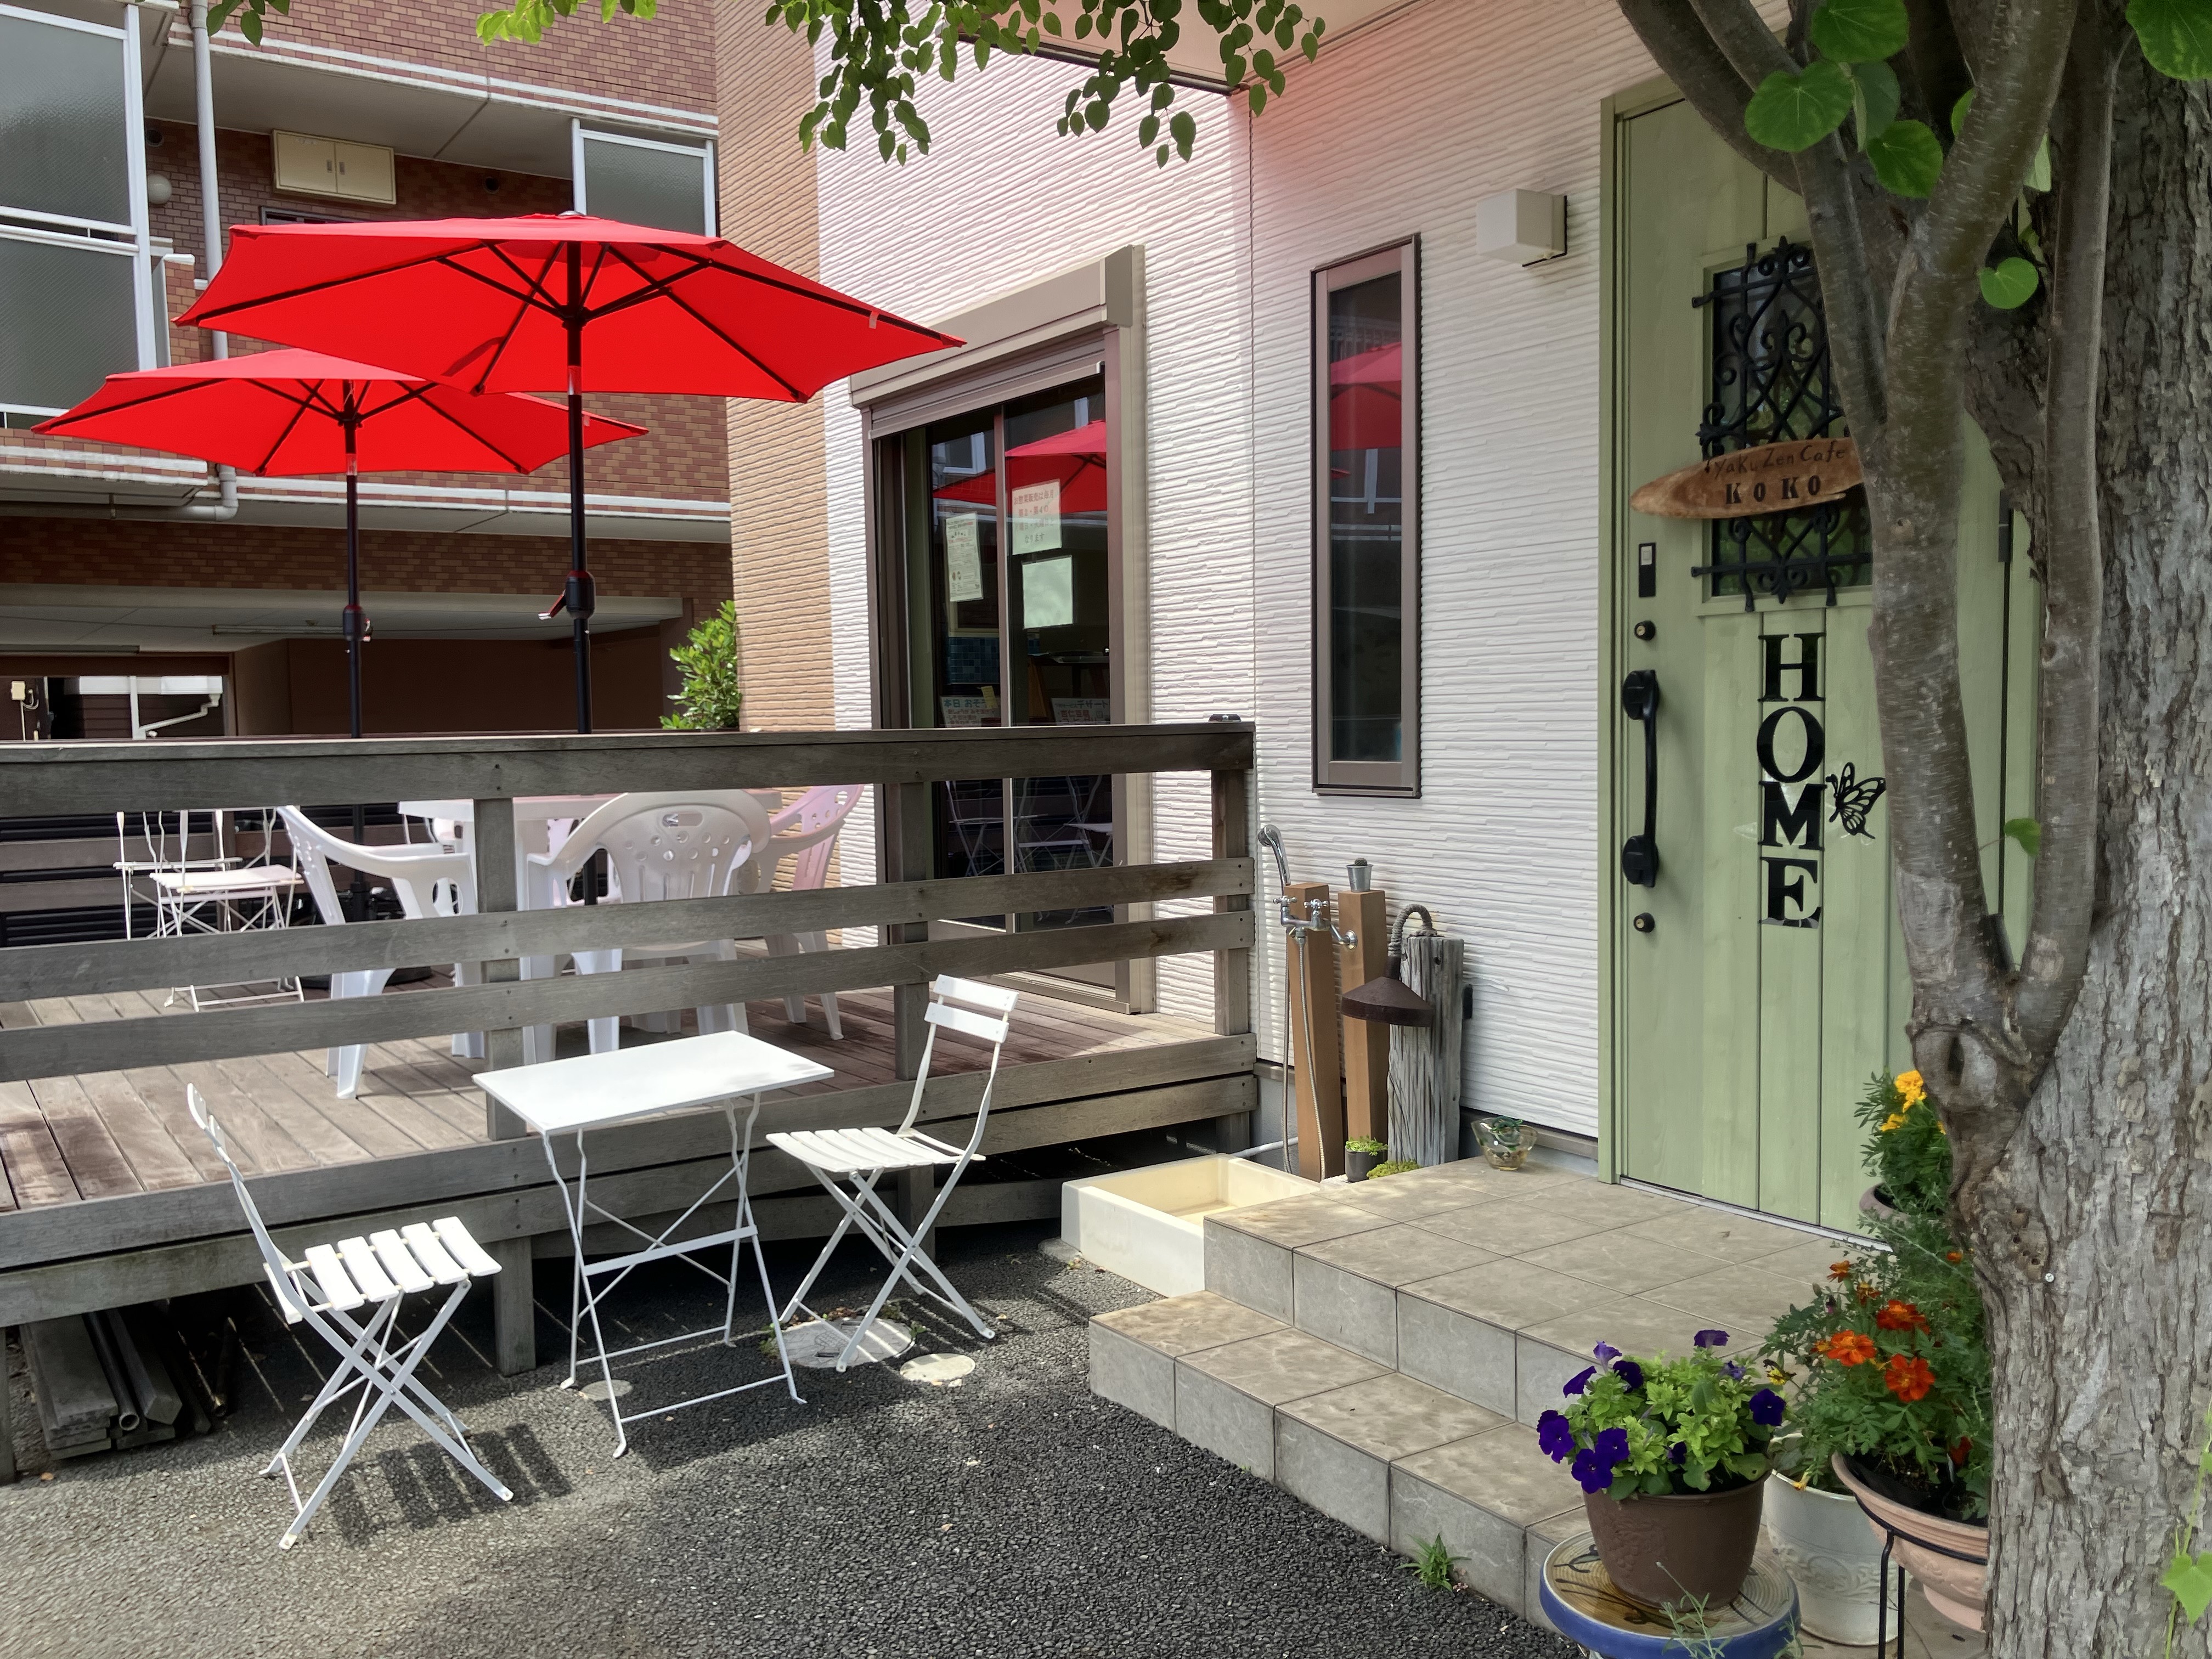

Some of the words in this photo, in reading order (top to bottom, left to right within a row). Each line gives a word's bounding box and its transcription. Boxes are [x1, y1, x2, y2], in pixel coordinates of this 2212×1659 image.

[1762, 448, 1795, 467] Zen
[1800, 441, 1846, 463] Cafe
[1726, 475, 1821, 504] KOKO
[1757, 632, 1827, 929] HOME
